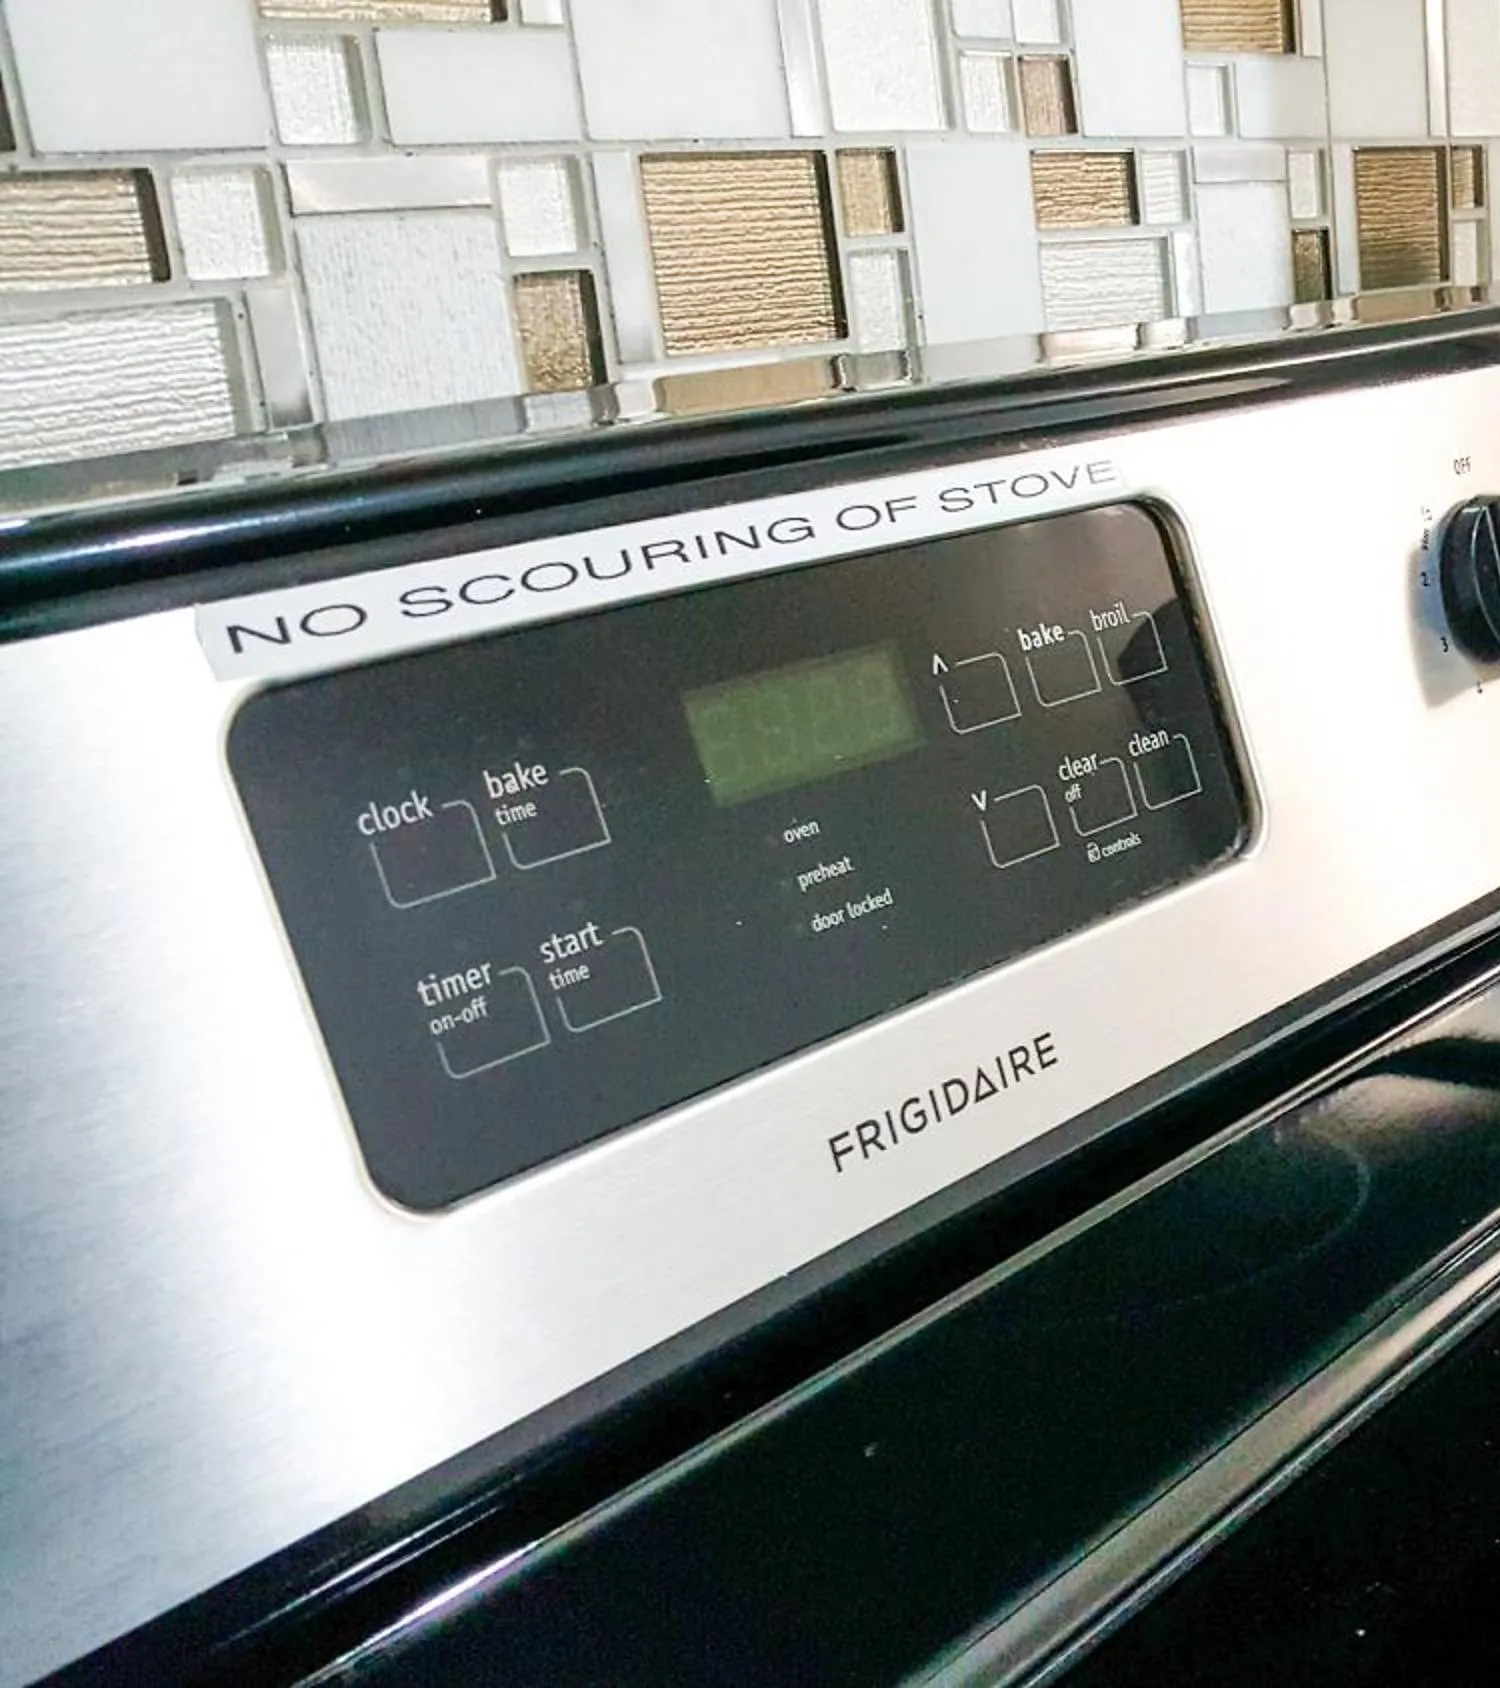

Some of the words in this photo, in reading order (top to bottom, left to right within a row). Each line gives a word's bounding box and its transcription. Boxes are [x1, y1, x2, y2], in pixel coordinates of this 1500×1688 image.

[226, 603, 368, 654] NO
[399, 516, 816, 618] SCOURING
[835, 495, 918, 532] OF
[938, 459, 1117, 514] STOVE
[1088, 601, 1131, 632] broil
[1016, 622, 1065, 652] bake
[1127, 728, 1170, 758] clean
[481, 761, 550, 799] bake
[1057, 753, 1100, 782] clear
[1064, 784, 1083, 804] off
[356, 789, 435, 836] clock
[495, 800, 539, 827] time
[783, 819, 821, 843] oven
[1101, 831, 1142, 858] controls
[796, 855, 855, 892] preheat
[810, 909, 845, 933] door
[845, 887, 894, 919] locked
[538, 921, 605, 964] start
[416, 961, 493, 1008] timer
[549, 963, 592, 991] time
[429, 994, 489, 1036] on-off
[827, 1031, 1060, 1174] FRIGIDAIRE
